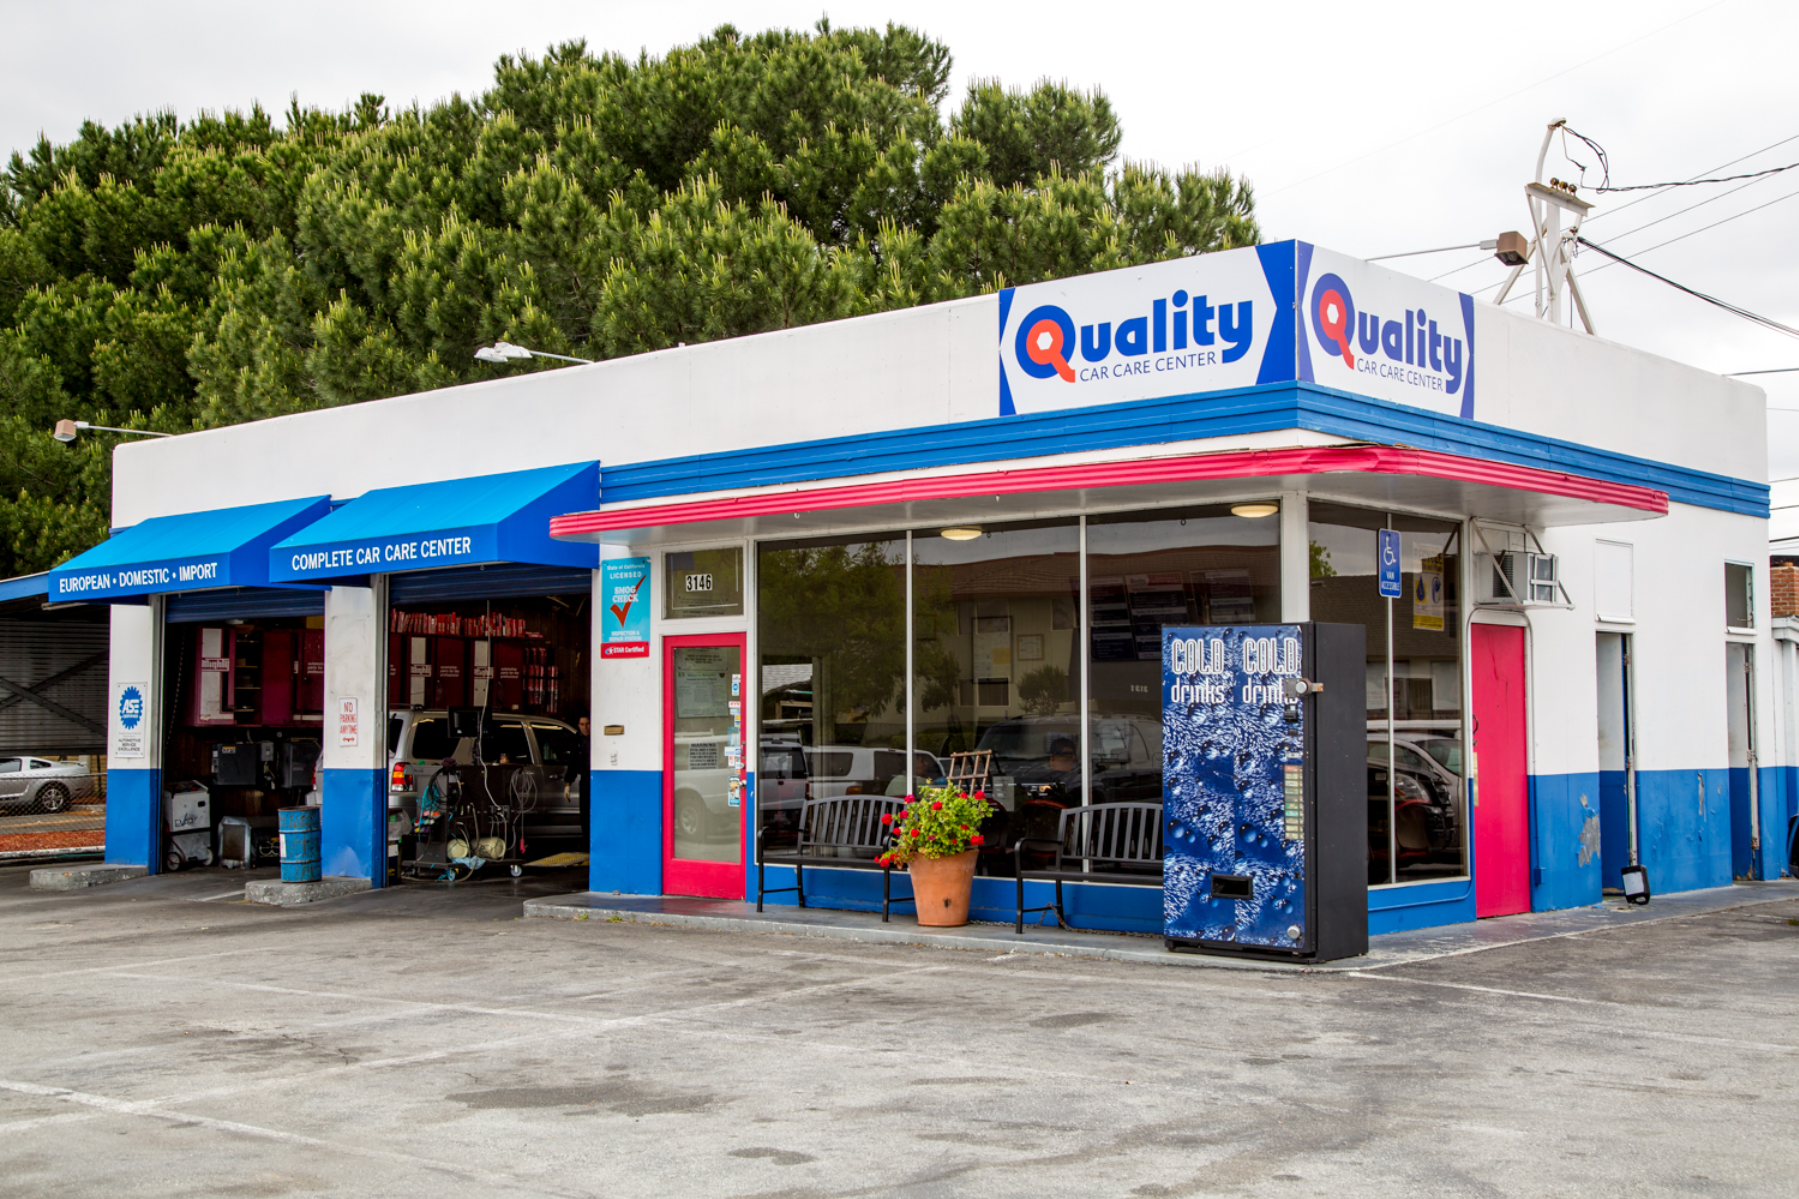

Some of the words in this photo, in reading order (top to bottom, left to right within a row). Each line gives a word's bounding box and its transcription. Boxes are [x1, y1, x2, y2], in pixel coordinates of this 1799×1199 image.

[1015, 289, 1253, 383] Quality
[1311, 272, 1462, 394] Quality
[1080, 366, 1109, 382] CAR
[1113, 360, 1150, 378] CARE
[1155, 351, 1216, 372] CENTER
[1357, 358, 1377, 376] CAR
[1379, 363, 1404, 382] CARE
[1406, 370, 1443, 392] CENTER
[292, 549, 353, 571] COMPLETE
[356, 547, 380, 564] CAR
[385, 542, 418, 561] CARE
[420, 536, 471, 558] CENTER
[59, 573, 111, 593] EUROPEAN
[119, 568, 169, 587] DOMESTIC
[179, 562, 217, 582] IMPORT
[610, 571, 642, 580] LICENSED
[687, 574, 712, 591] 3146
[1386, 571, 1395, 580] VAN
[614, 585, 636, 595] SMOG
[1381, 581, 1400, 591] ACCESSIBLE
[612, 594, 639, 603] CHECK
[1172, 638, 1224, 674] COLD
[1243, 637, 1298, 674] COLD
[1171, 677, 1225, 704] drinks
[122, 699, 140, 714] ASE
[344, 702, 353, 713] NO
[340, 714, 356, 723] PARKING
[340, 724, 357, 734] ANYTIME
